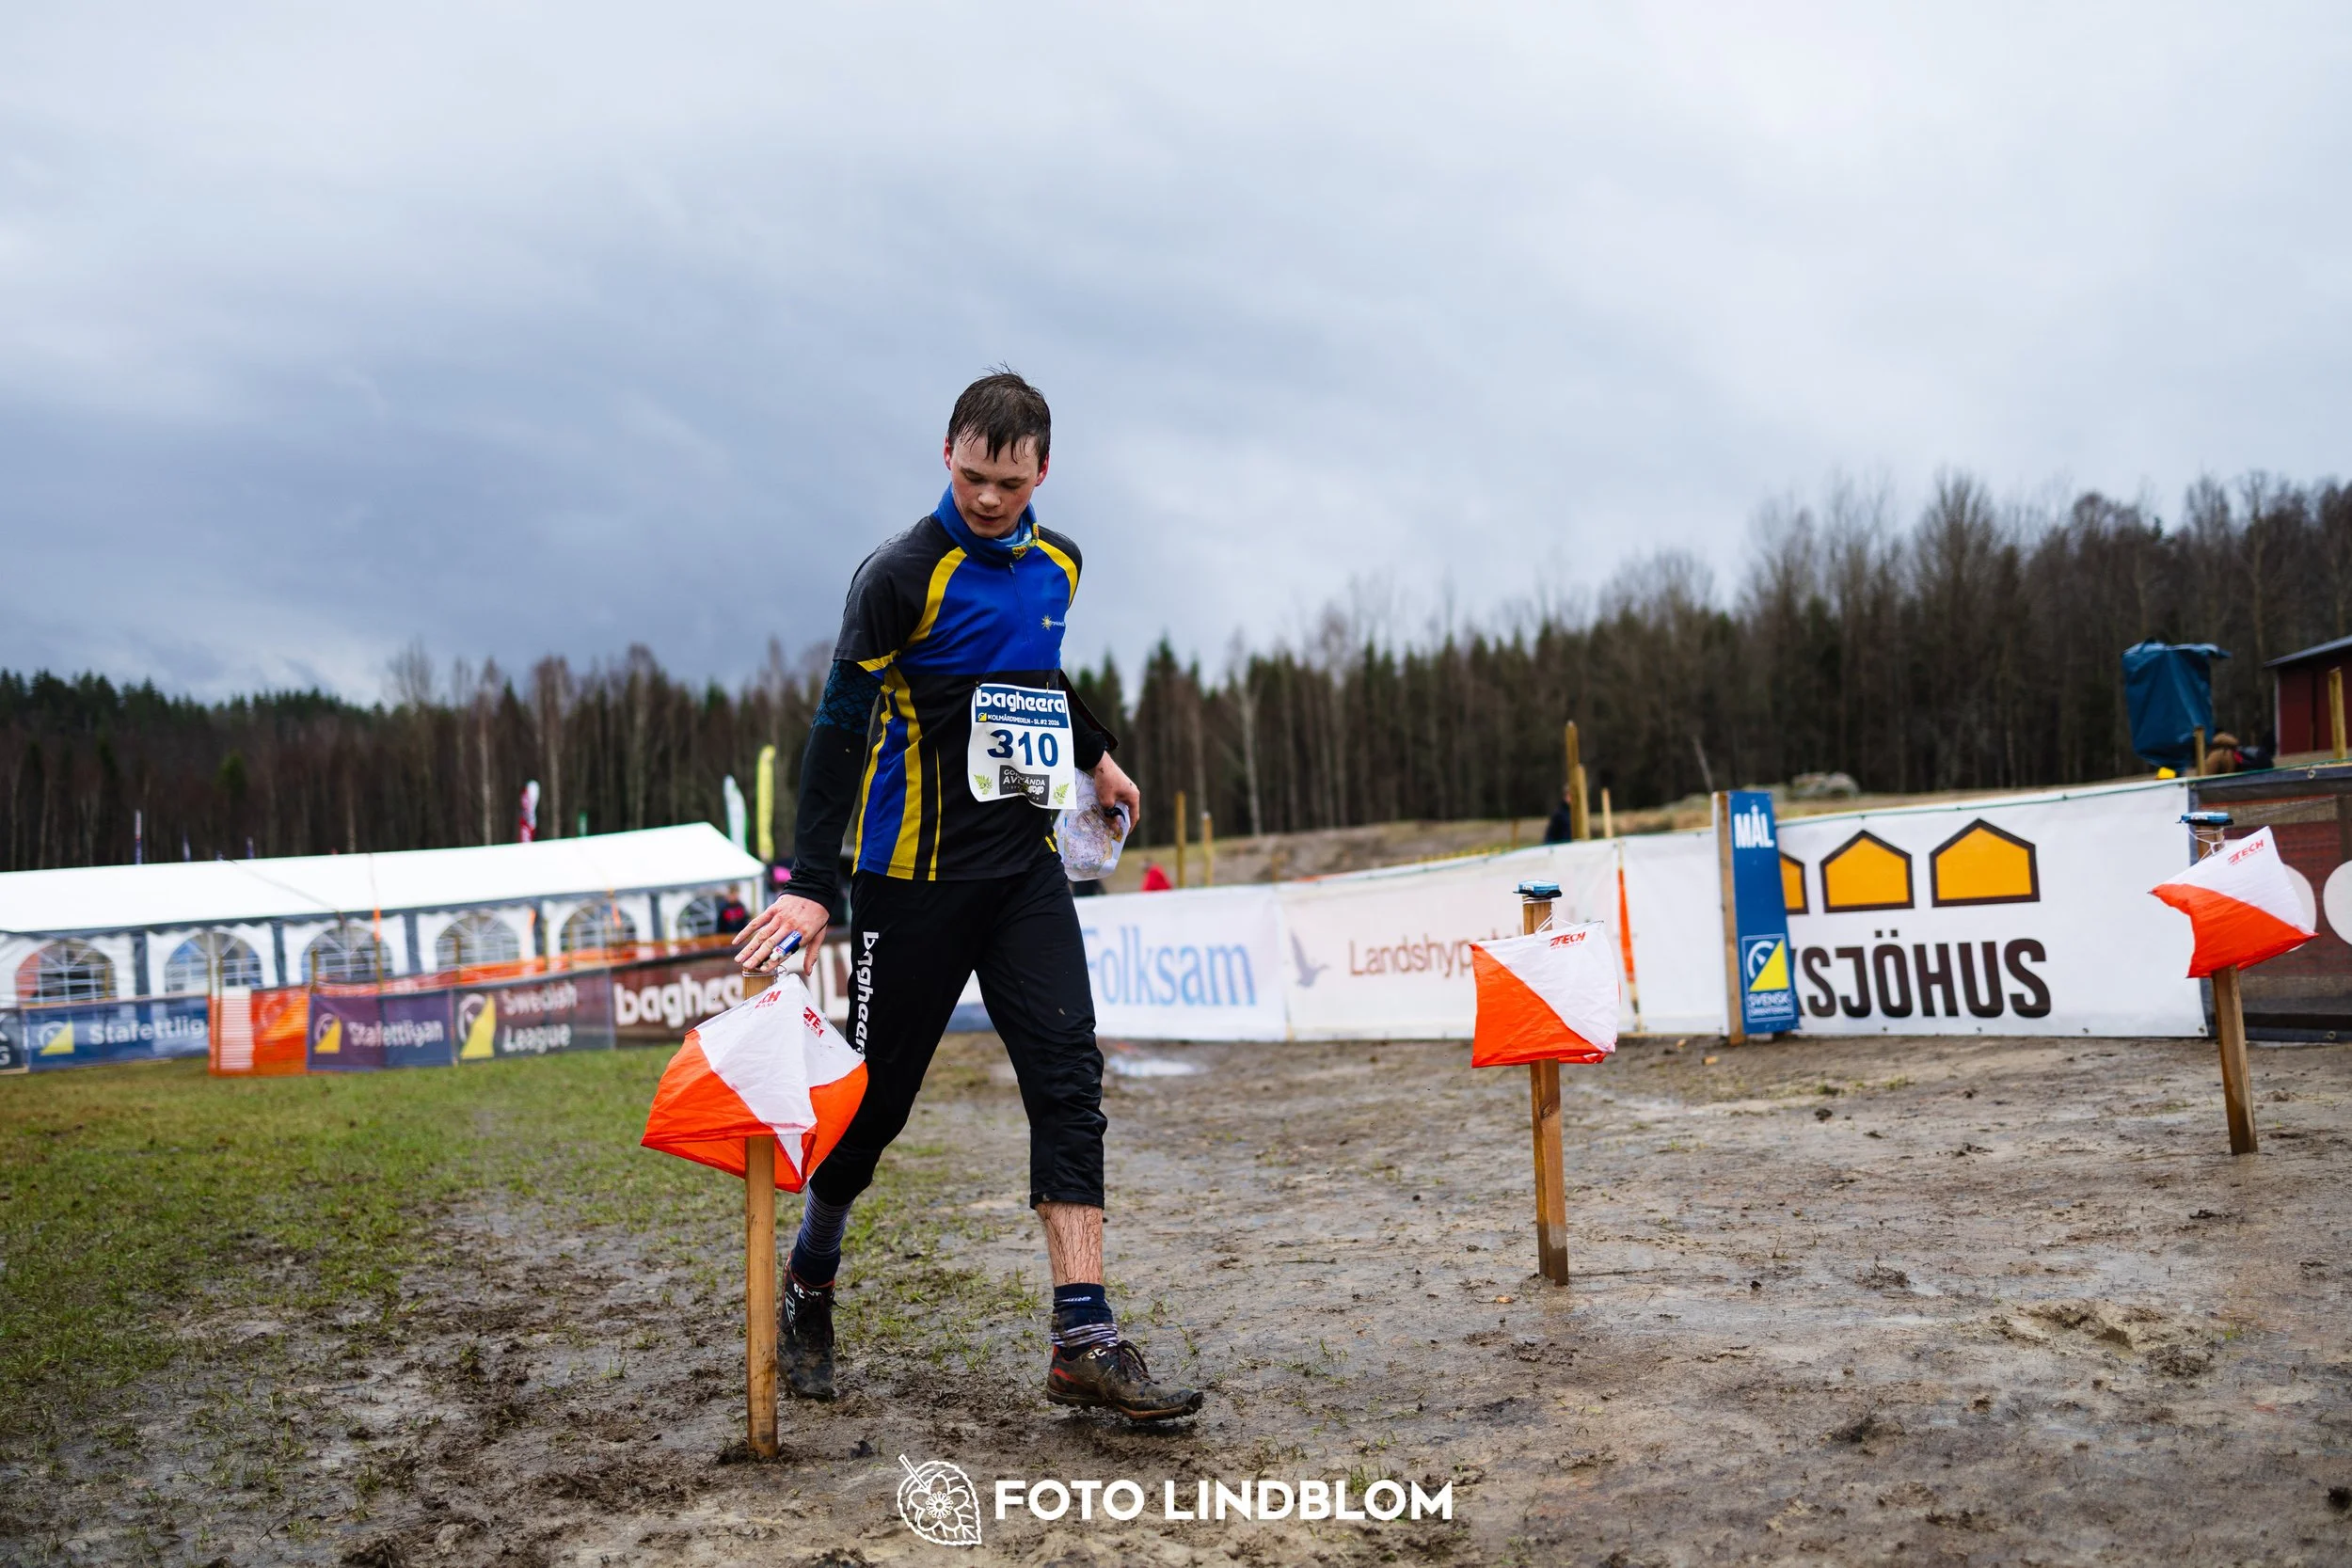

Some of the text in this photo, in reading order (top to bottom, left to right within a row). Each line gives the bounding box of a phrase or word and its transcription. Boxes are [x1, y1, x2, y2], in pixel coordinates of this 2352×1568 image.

[976, 689, 1066, 713] bagheera
[987, 729, 1058, 768] 310
[1734, 804, 1774, 848] MÅL
[501, 984, 577, 1015] Swedish
[88, 1015, 209, 1045] Stafettlig
[502, 1022, 572, 1053] League
